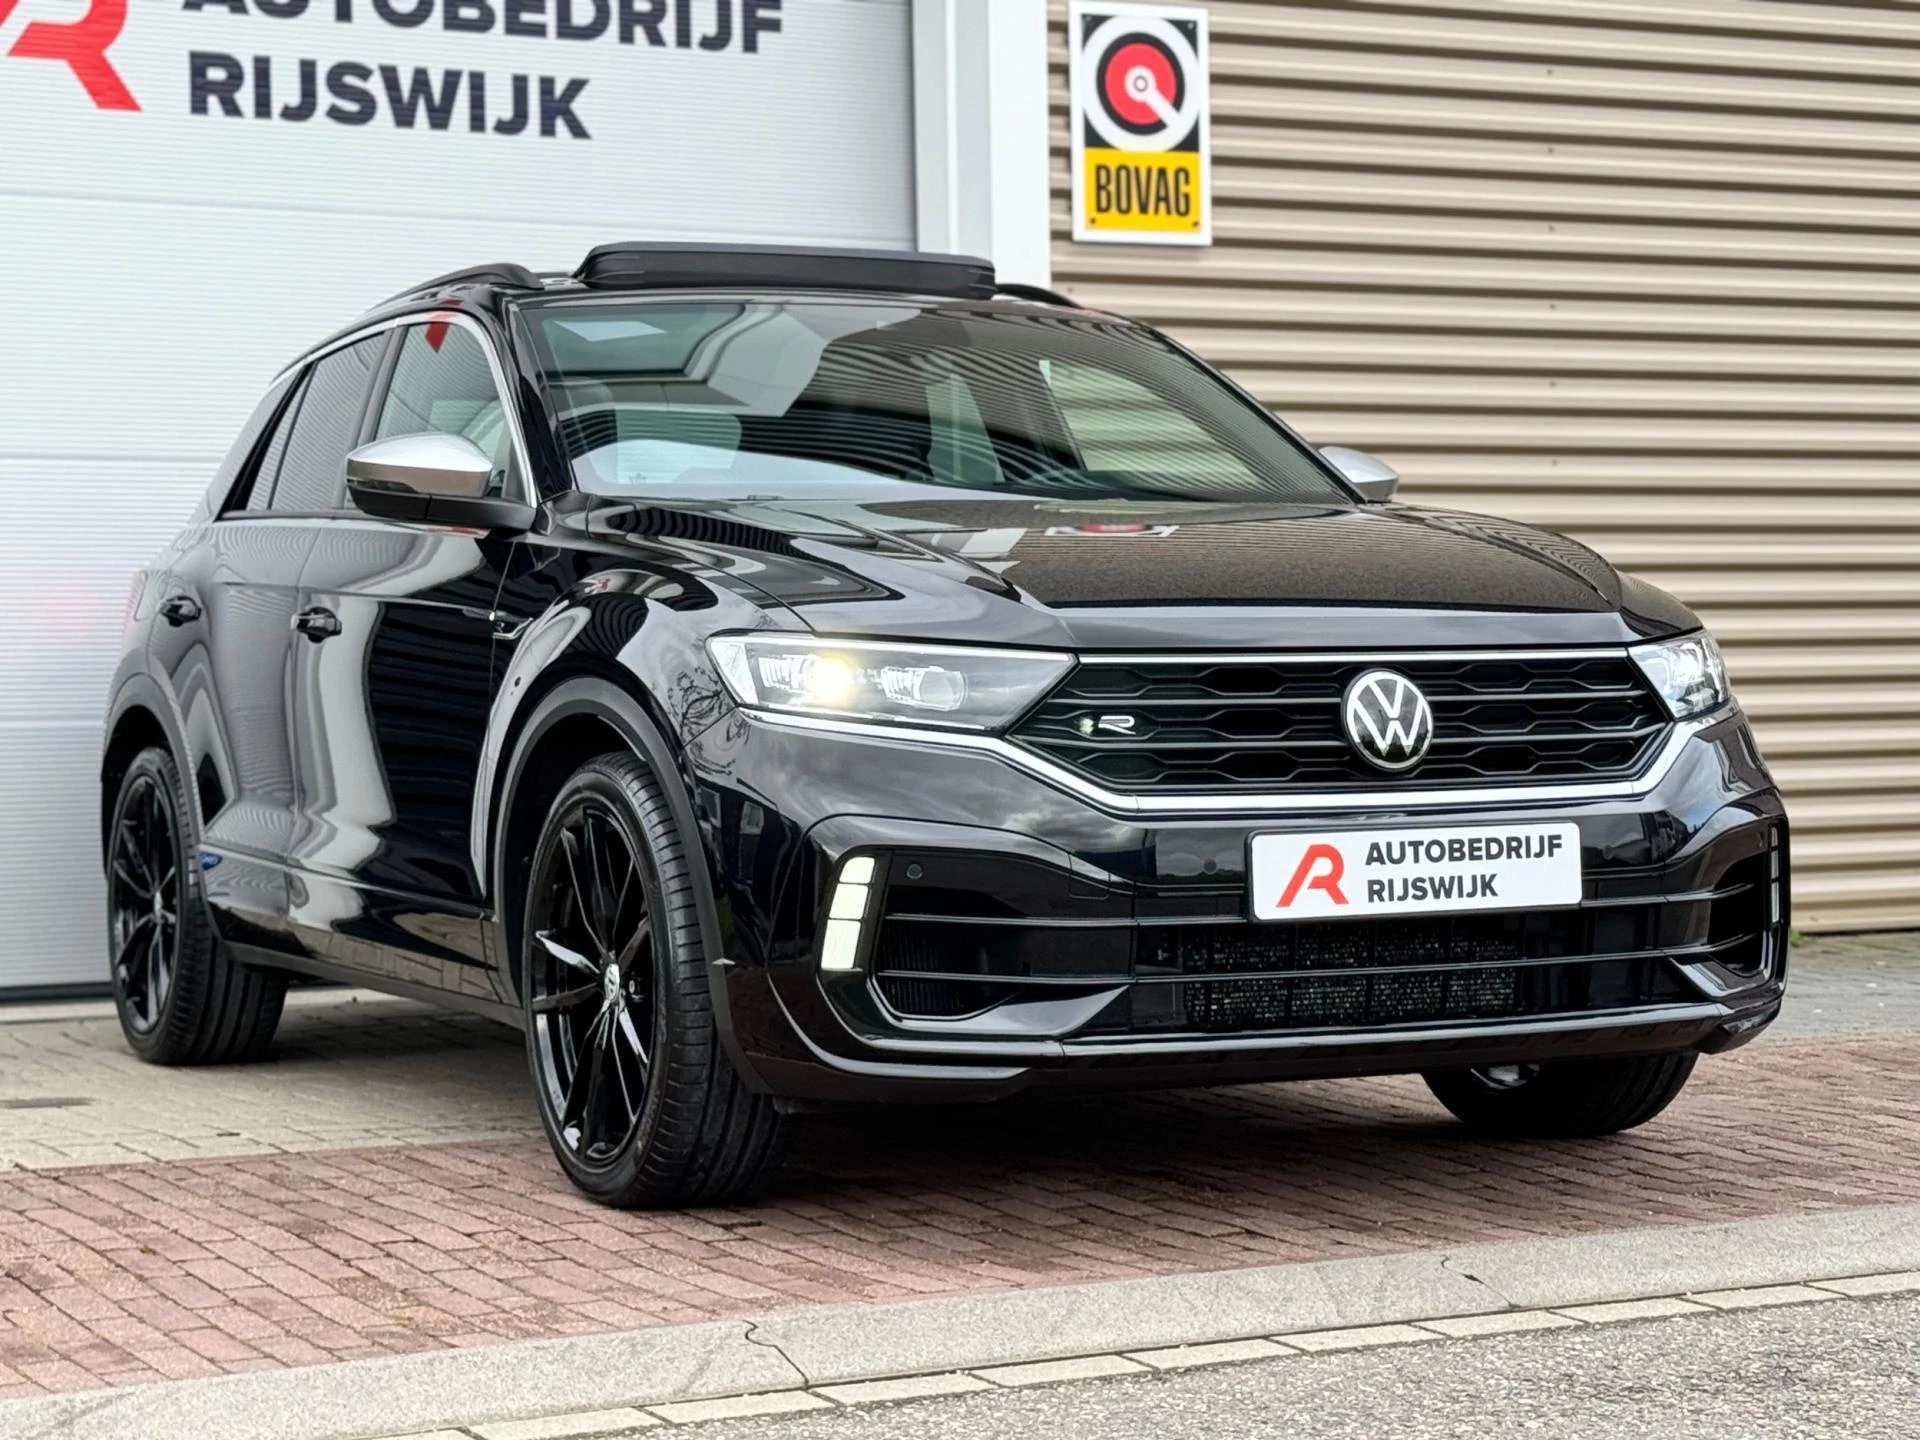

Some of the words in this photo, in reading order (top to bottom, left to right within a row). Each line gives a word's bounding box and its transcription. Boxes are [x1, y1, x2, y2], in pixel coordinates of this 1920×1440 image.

[182, 0, 781, 53] BEDRIJF
[189, 51, 592, 139] RIJSWIJK
[1095, 164, 1190, 216] BOVAG
[1365, 834, 1562, 866] AUTOBEDRIJF
[1367, 873, 1498, 903] RIJSWIJK
